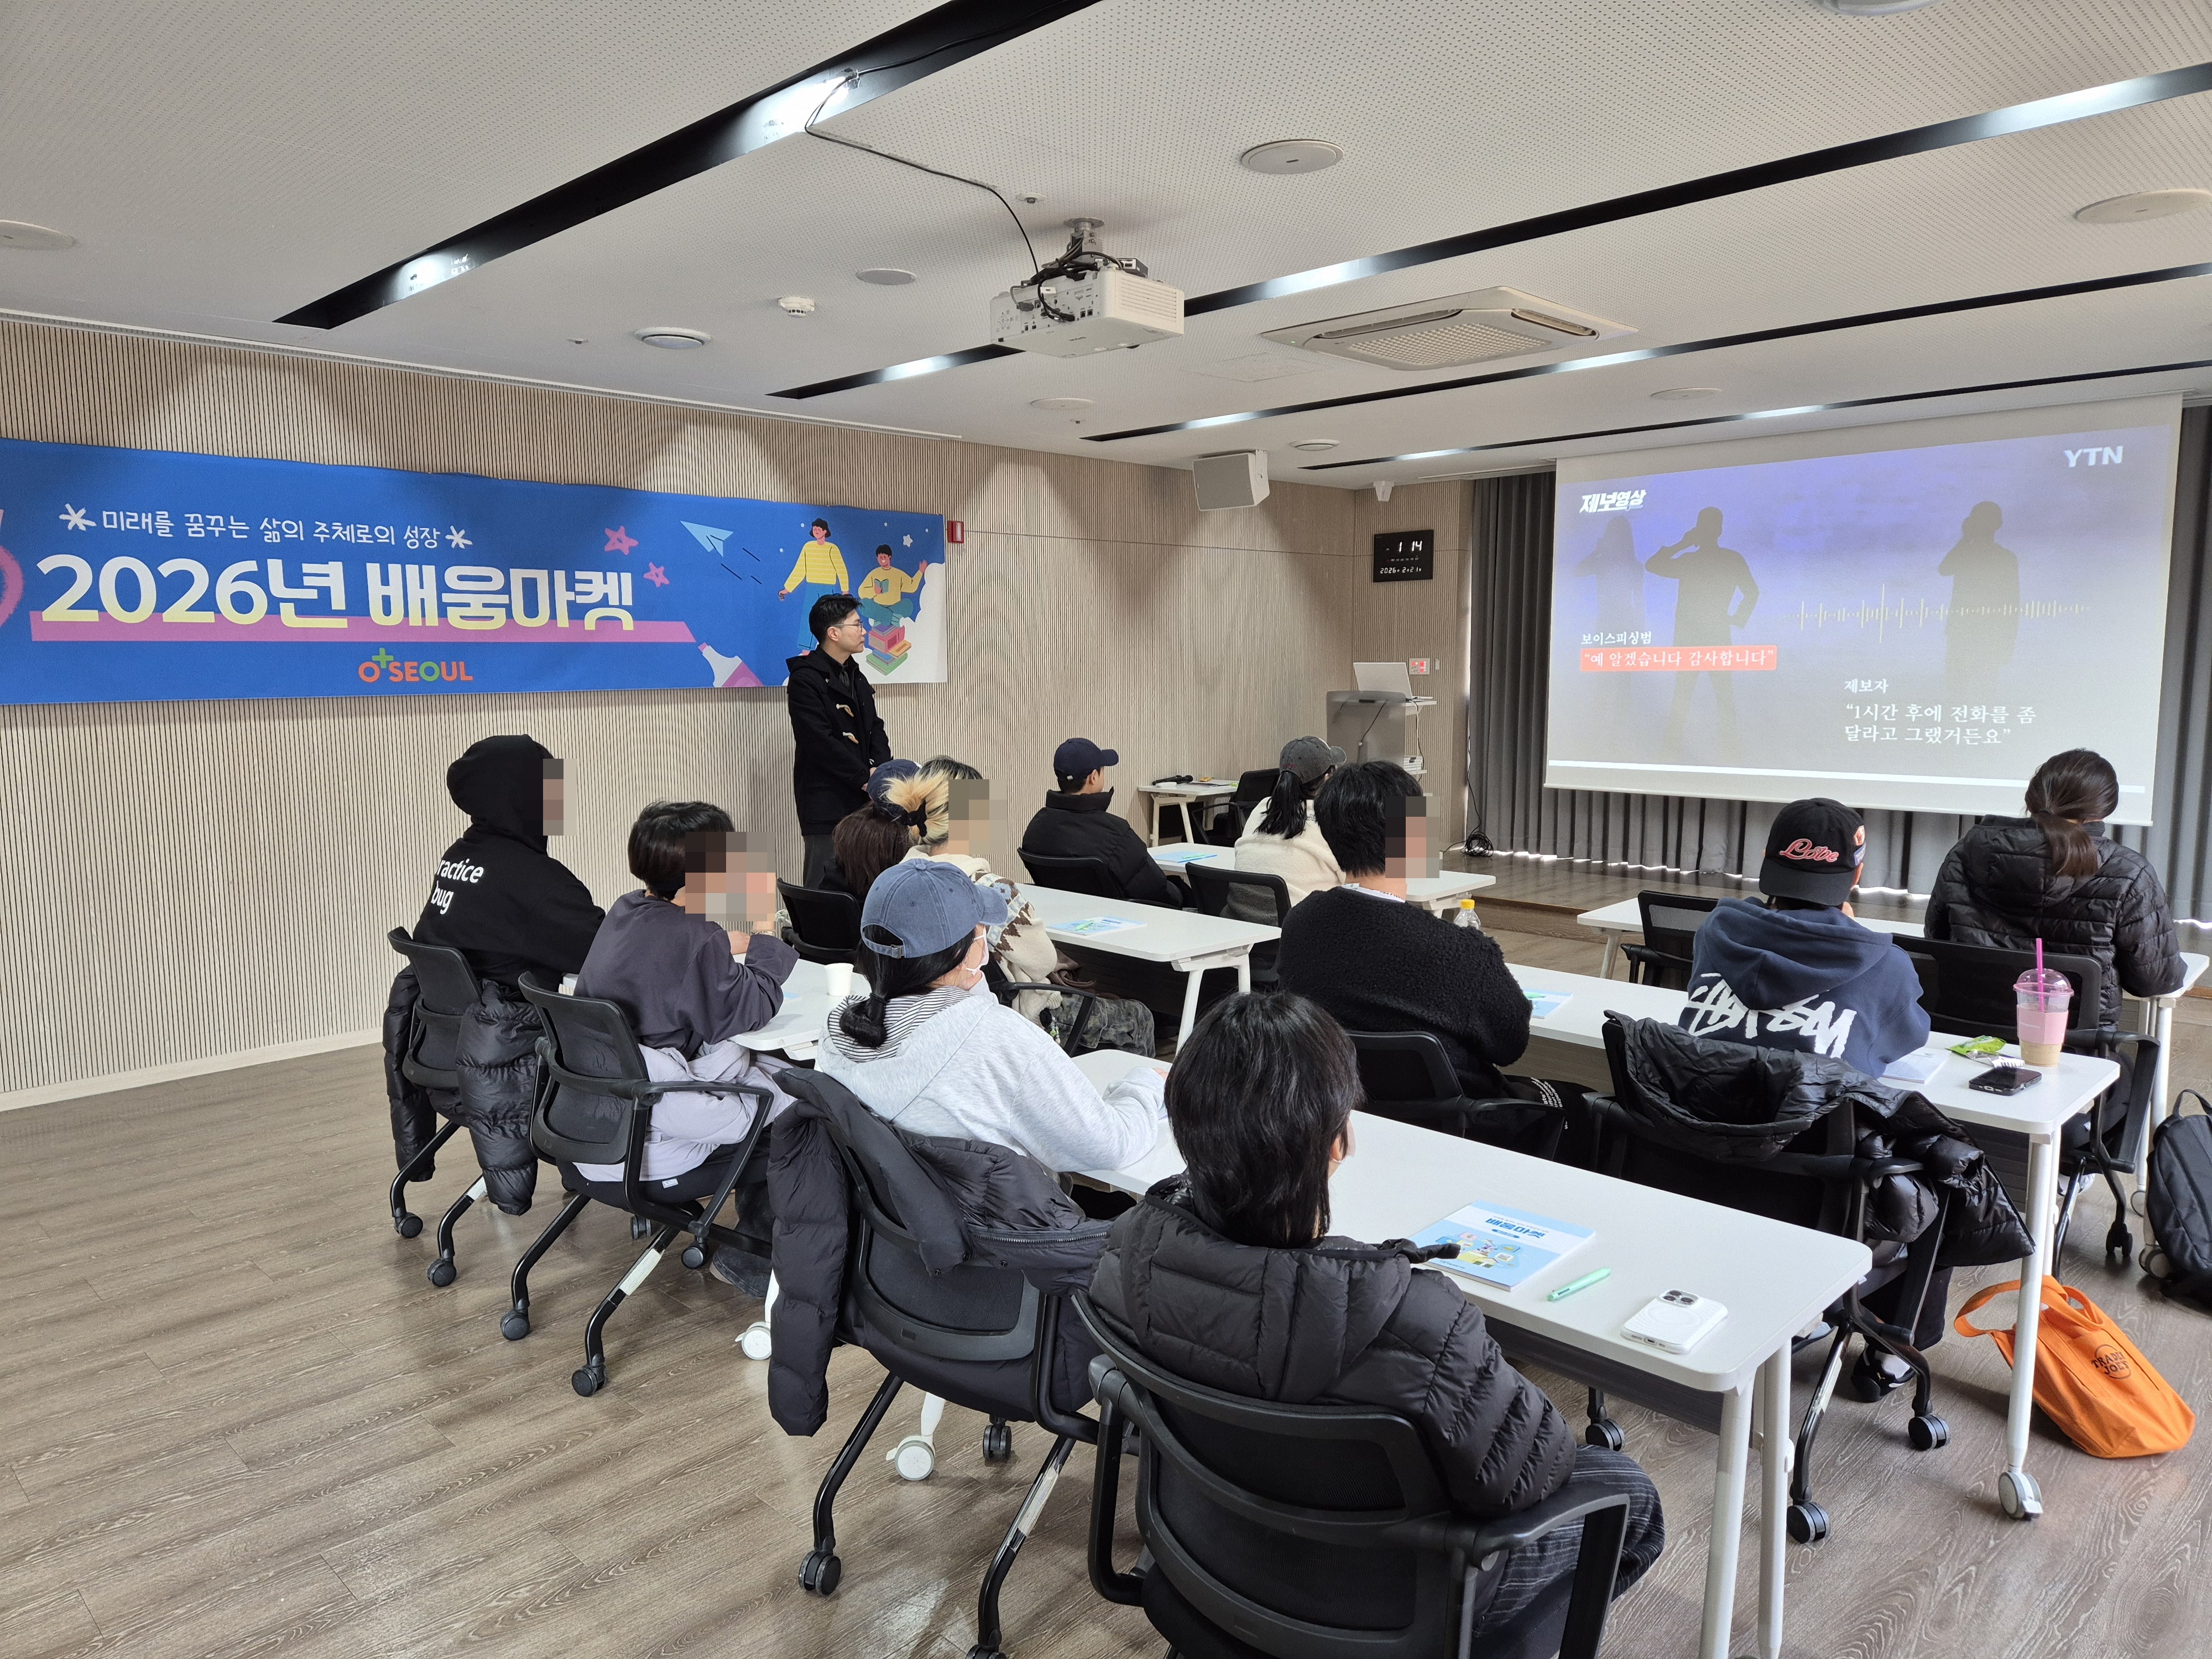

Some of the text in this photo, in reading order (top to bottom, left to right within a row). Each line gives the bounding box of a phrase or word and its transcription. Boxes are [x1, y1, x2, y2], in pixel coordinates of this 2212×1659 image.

[2064, 446, 2124, 467] YTN
[1579, 489, 1647, 513] 제보영상
[102, 510, 441, 549] 미래를 꿈꾸는 삶의 주체로의 성장
[36, 554, 634, 631] 2026년 배움마켓
[1580, 631, 1652, 645] 보이스피싱범
[1610, 651, 1682, 667] 알겠습니다
[1844, 679, 1888, 693] 제보자
[1905, 704, 1942, 722] 후에
[1950, 705, 2009, 724] 전화를
[2017, 706, 2037, 724] 좀
[1845, 724, 1898, 743] 달라고
[1780, 838, 1839, 863] Love
[436, 858, 484, 883] ractice
